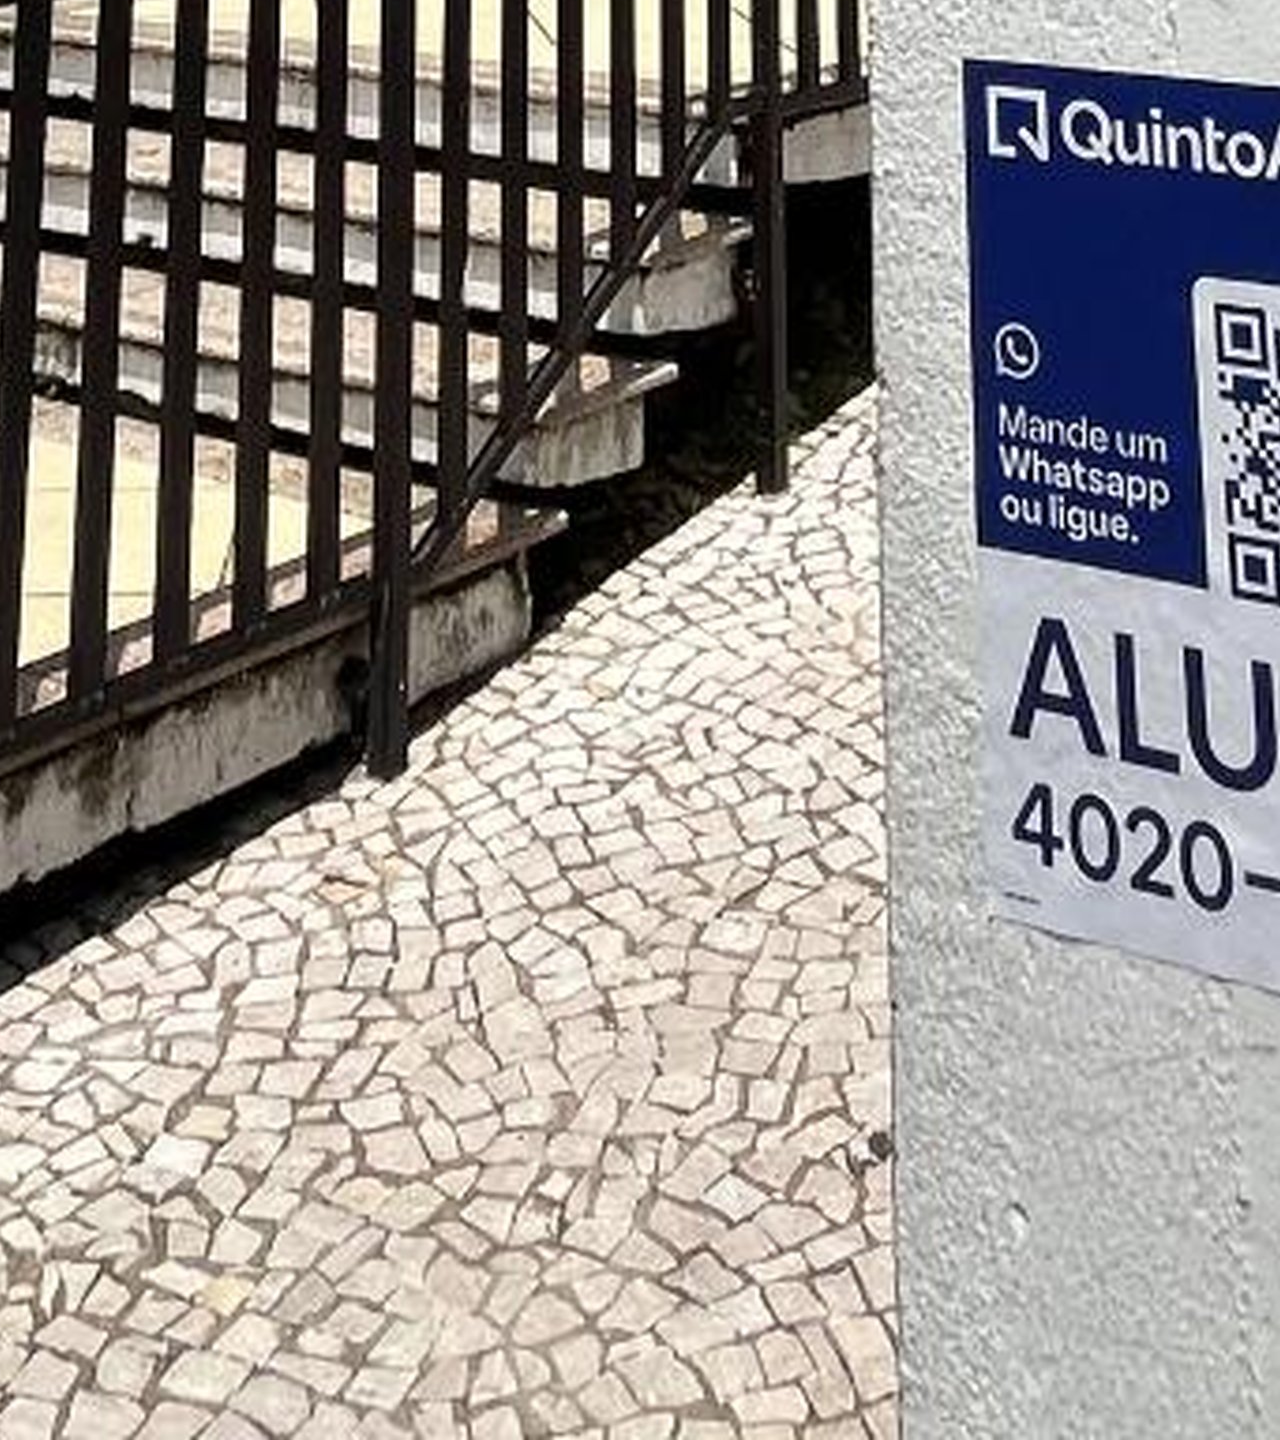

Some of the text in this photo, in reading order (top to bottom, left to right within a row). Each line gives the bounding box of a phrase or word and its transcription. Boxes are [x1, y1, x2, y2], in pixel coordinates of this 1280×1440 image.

[999, 402, 1168, 464] Mande um
[998, 443, 1171, 511] Whatsapp
[1000, 494, 1140, 544] ou ligue.
